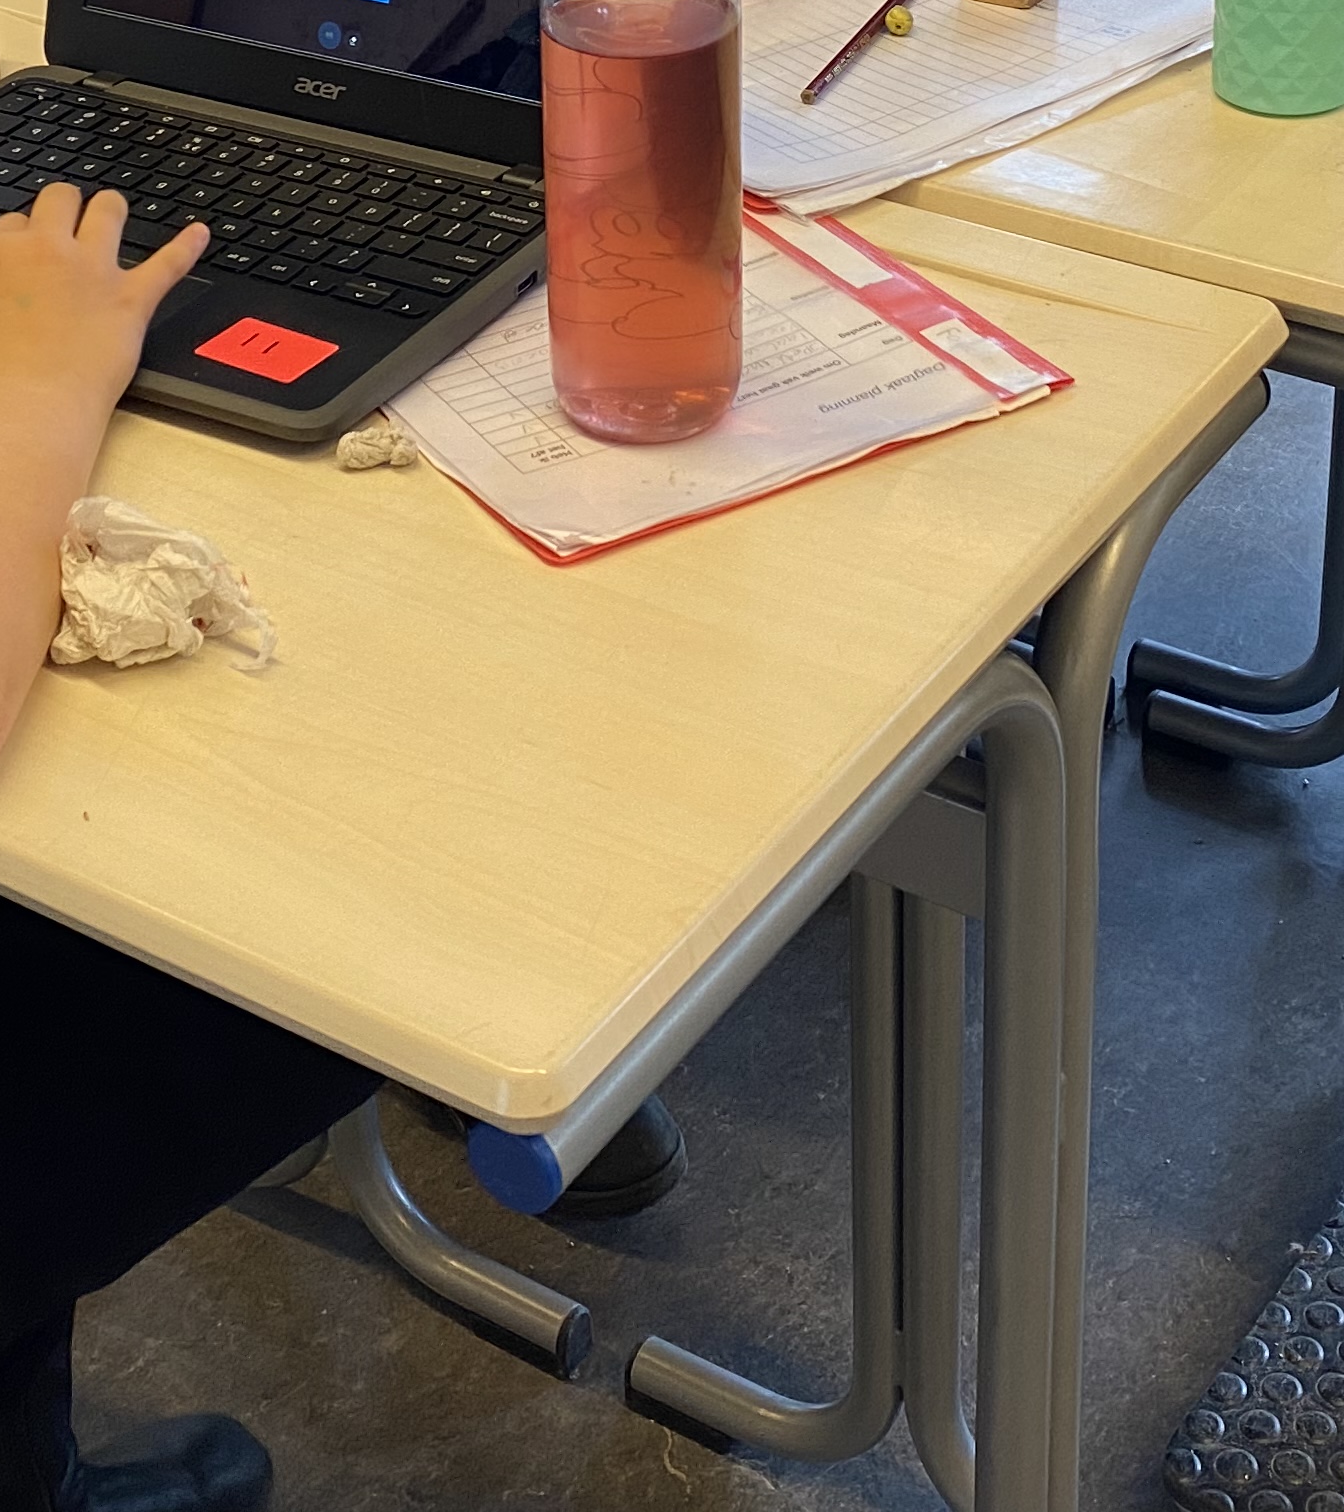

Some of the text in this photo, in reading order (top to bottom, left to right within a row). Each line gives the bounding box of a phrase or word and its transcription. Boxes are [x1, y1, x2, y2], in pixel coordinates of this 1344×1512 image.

[293, 76, 347, 100] acer
[489, 210, 529, 225] backspace
[454, 254, 478, 264] enter
[838, 319, 882, 339] Maandag
[824, 359, 842, 369] Om
[818, 361, 946, 414] Dagtaak planning
